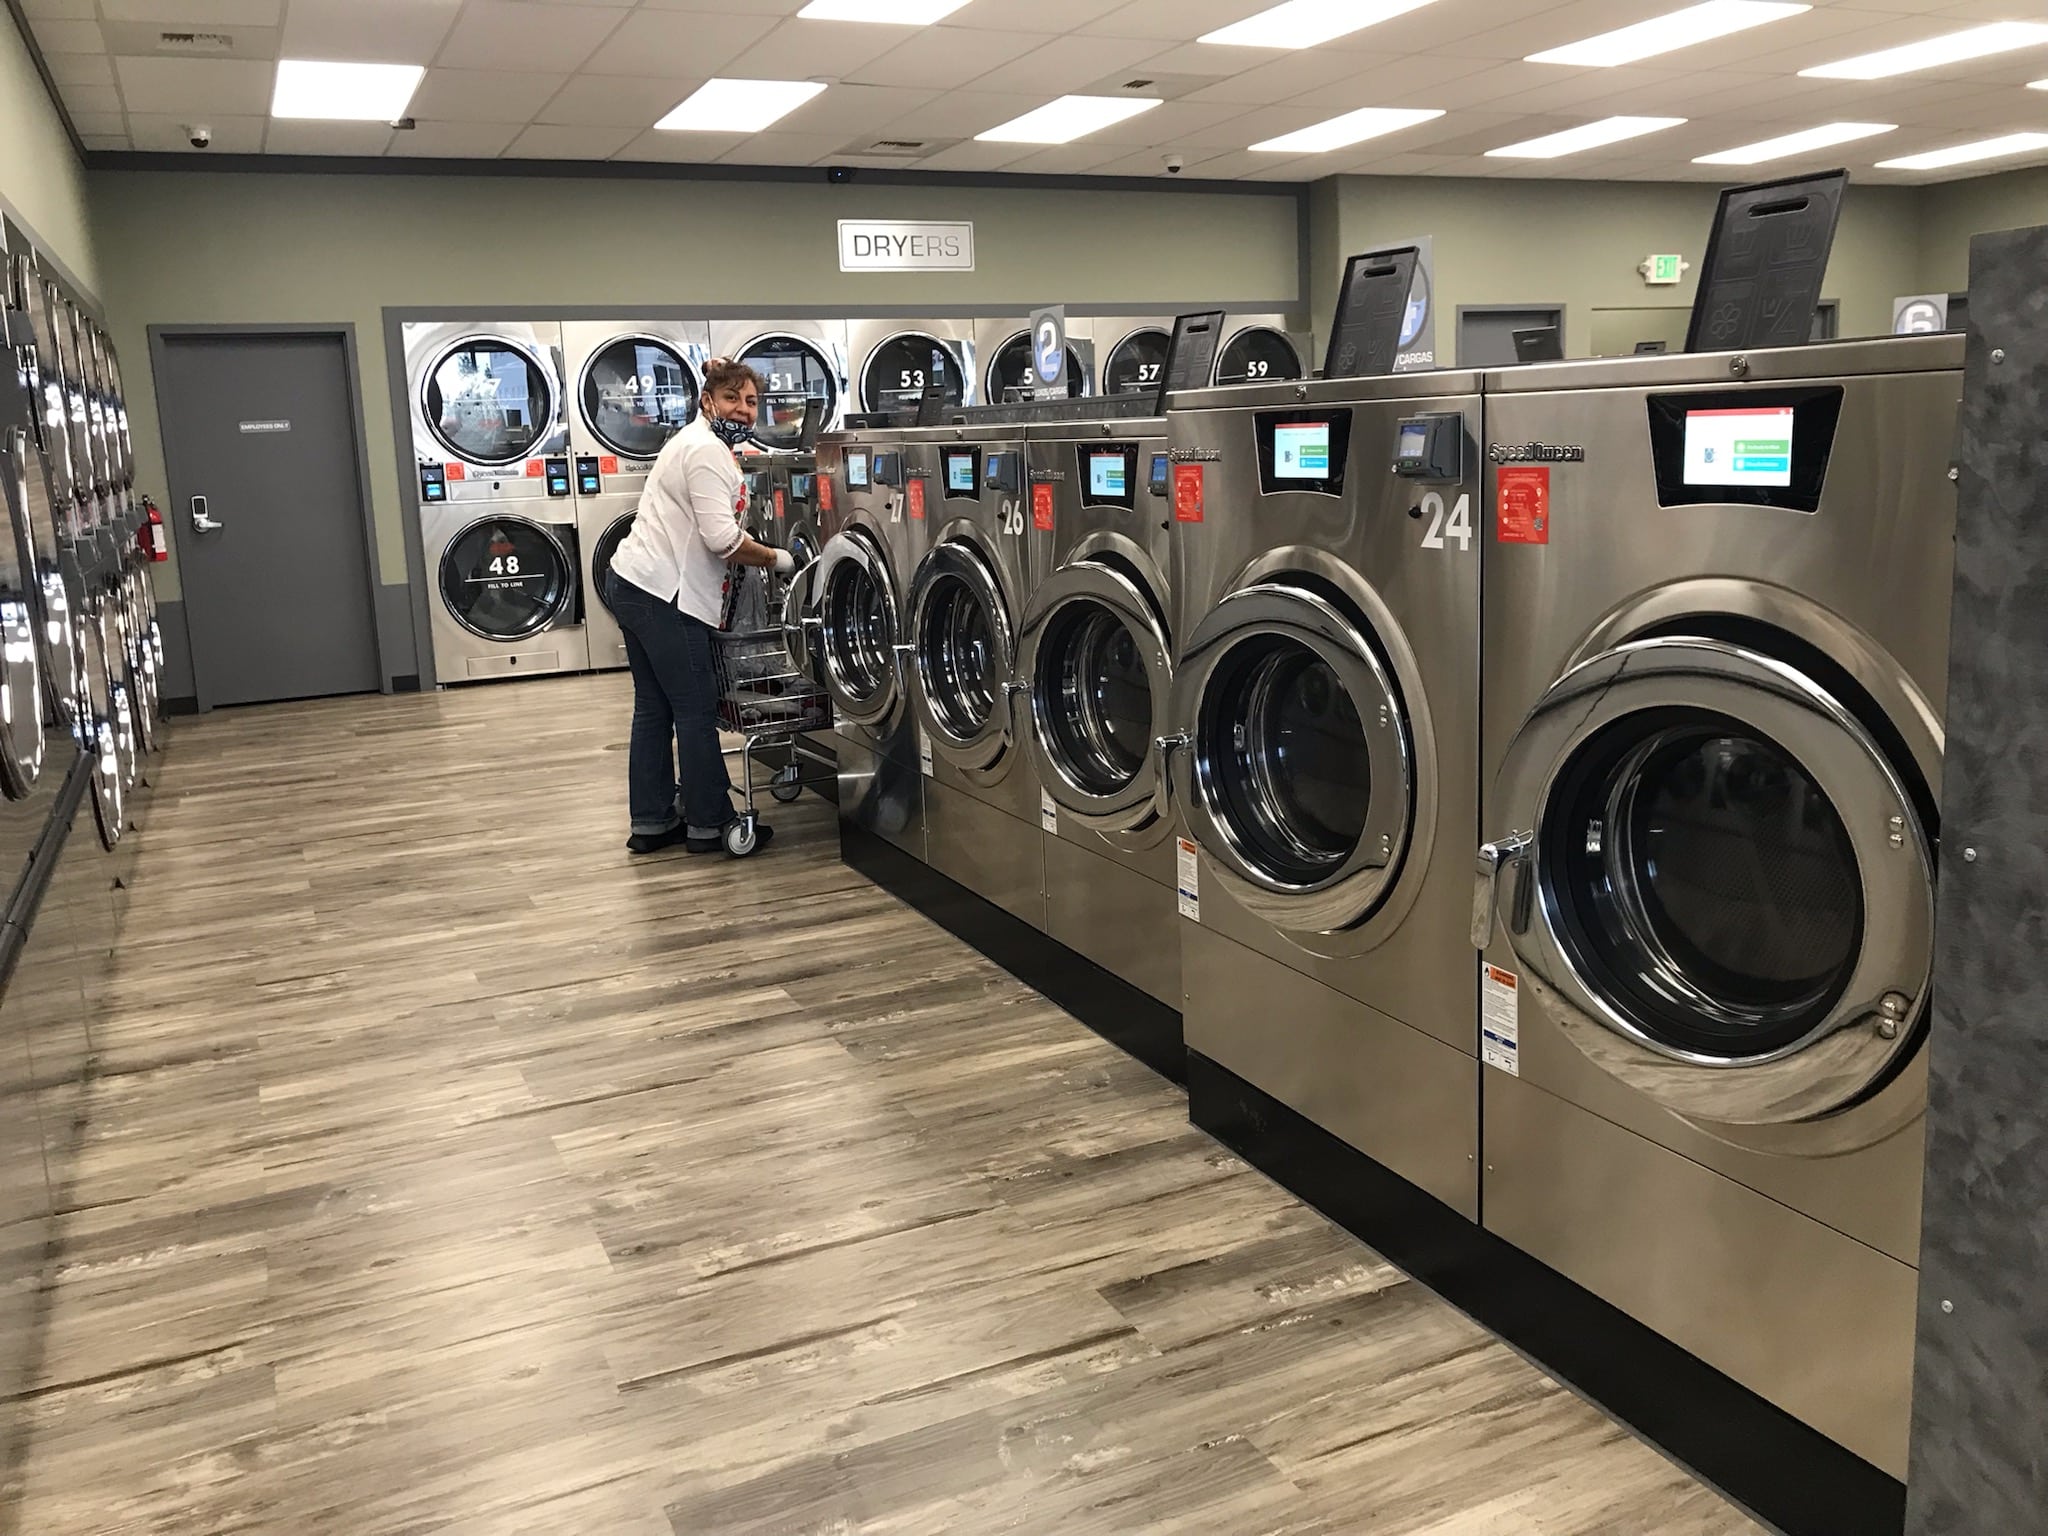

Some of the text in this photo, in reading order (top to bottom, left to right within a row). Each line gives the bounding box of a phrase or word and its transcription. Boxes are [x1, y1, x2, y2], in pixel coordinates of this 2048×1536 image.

[854, 235, 960, 257] DRYERS
[1039, 321, 1057, 373] 2
[900, 369, 925, 388] 53
[1023, 367, 1033, 385] 5
[1138, 364, 1161, 381] 57
[1247, 361, 1268, 377] 59
[625, 375, 654, 393] 49
[769, 373, 793, 391] 51
[1489, 441, 1585, 465] Speed Queen
[1002, 499, 1024, 536] 26
[1420, 491, 1473, 551] 24
[488, 555, 520, 575] 48
